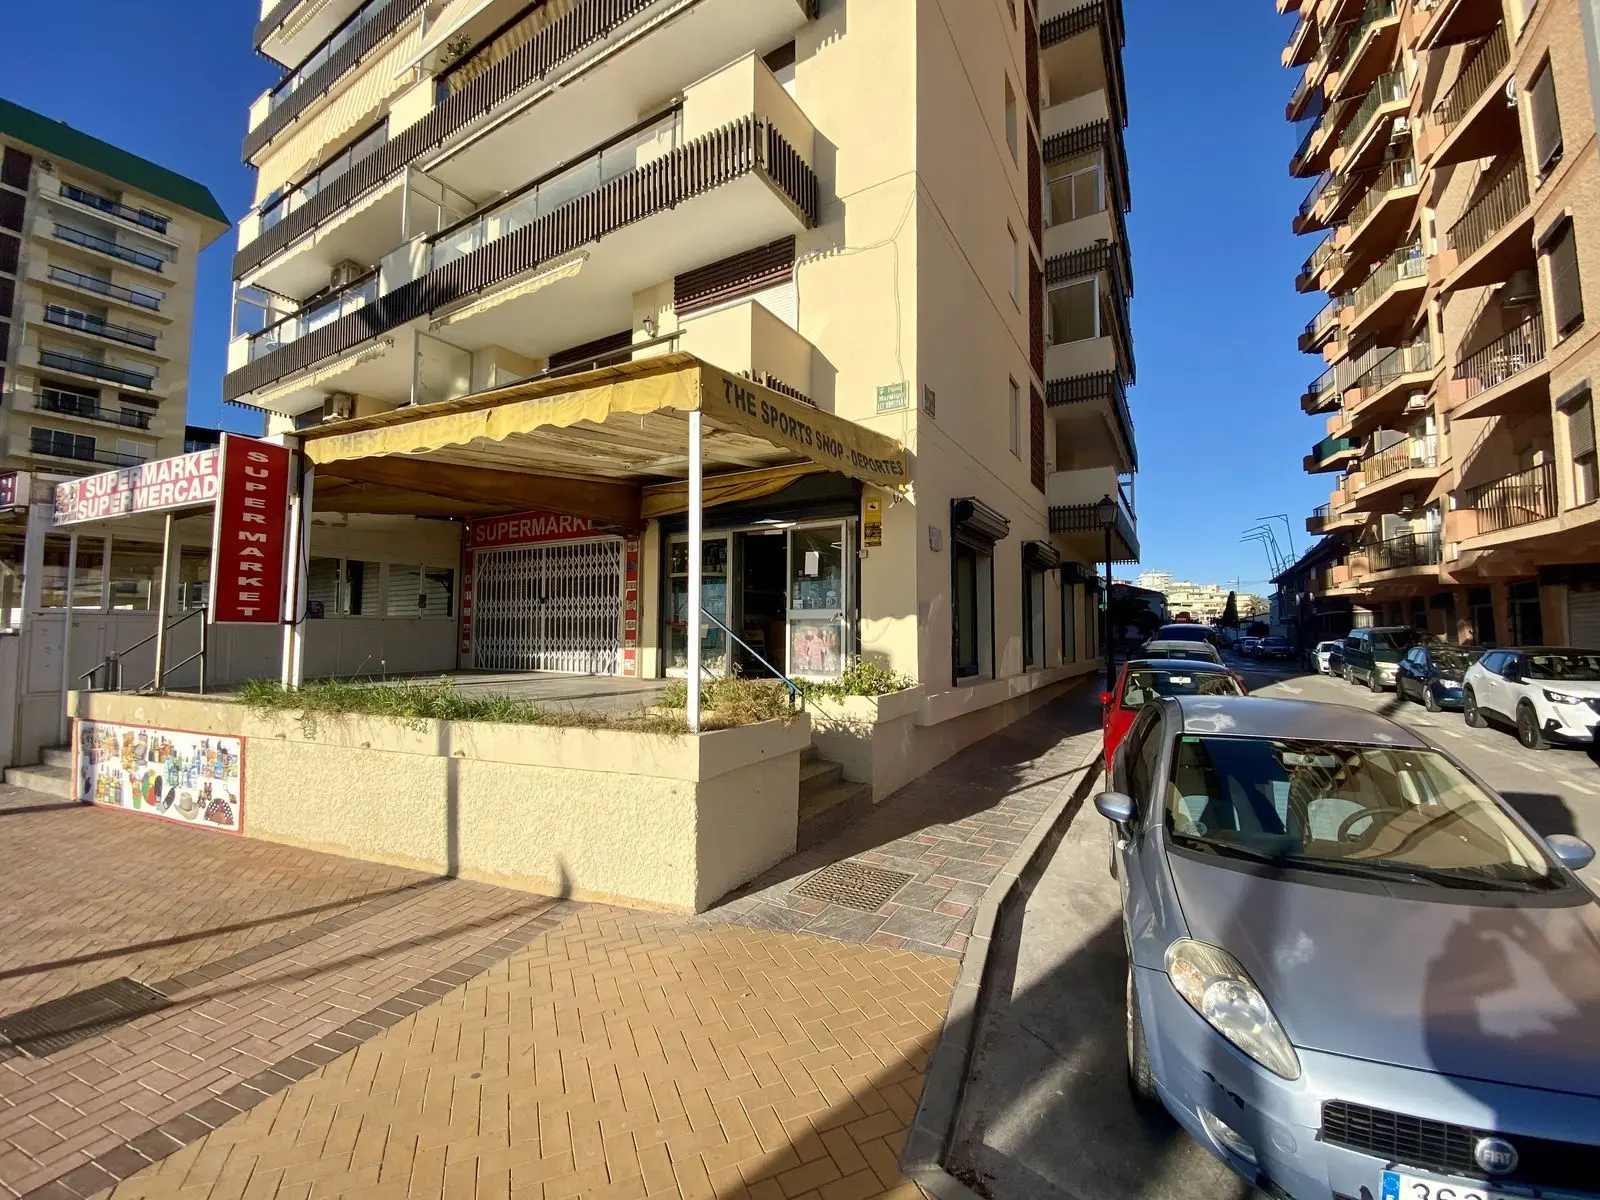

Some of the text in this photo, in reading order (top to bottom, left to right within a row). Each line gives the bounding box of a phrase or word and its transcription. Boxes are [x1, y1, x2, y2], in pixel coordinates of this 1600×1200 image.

[721, 377, 757, 417] THE
[761, 400, 812, 446] SPORTS
[816, 431, 844, 460] SHOP
[851, 450, 904, 475] DEPORTES
[236, 451, 270, 617] SUPERMARKET
[476, 515, 593, 542] SUPERMARK
[1482, 1149, 1511, 1165] FIAT
